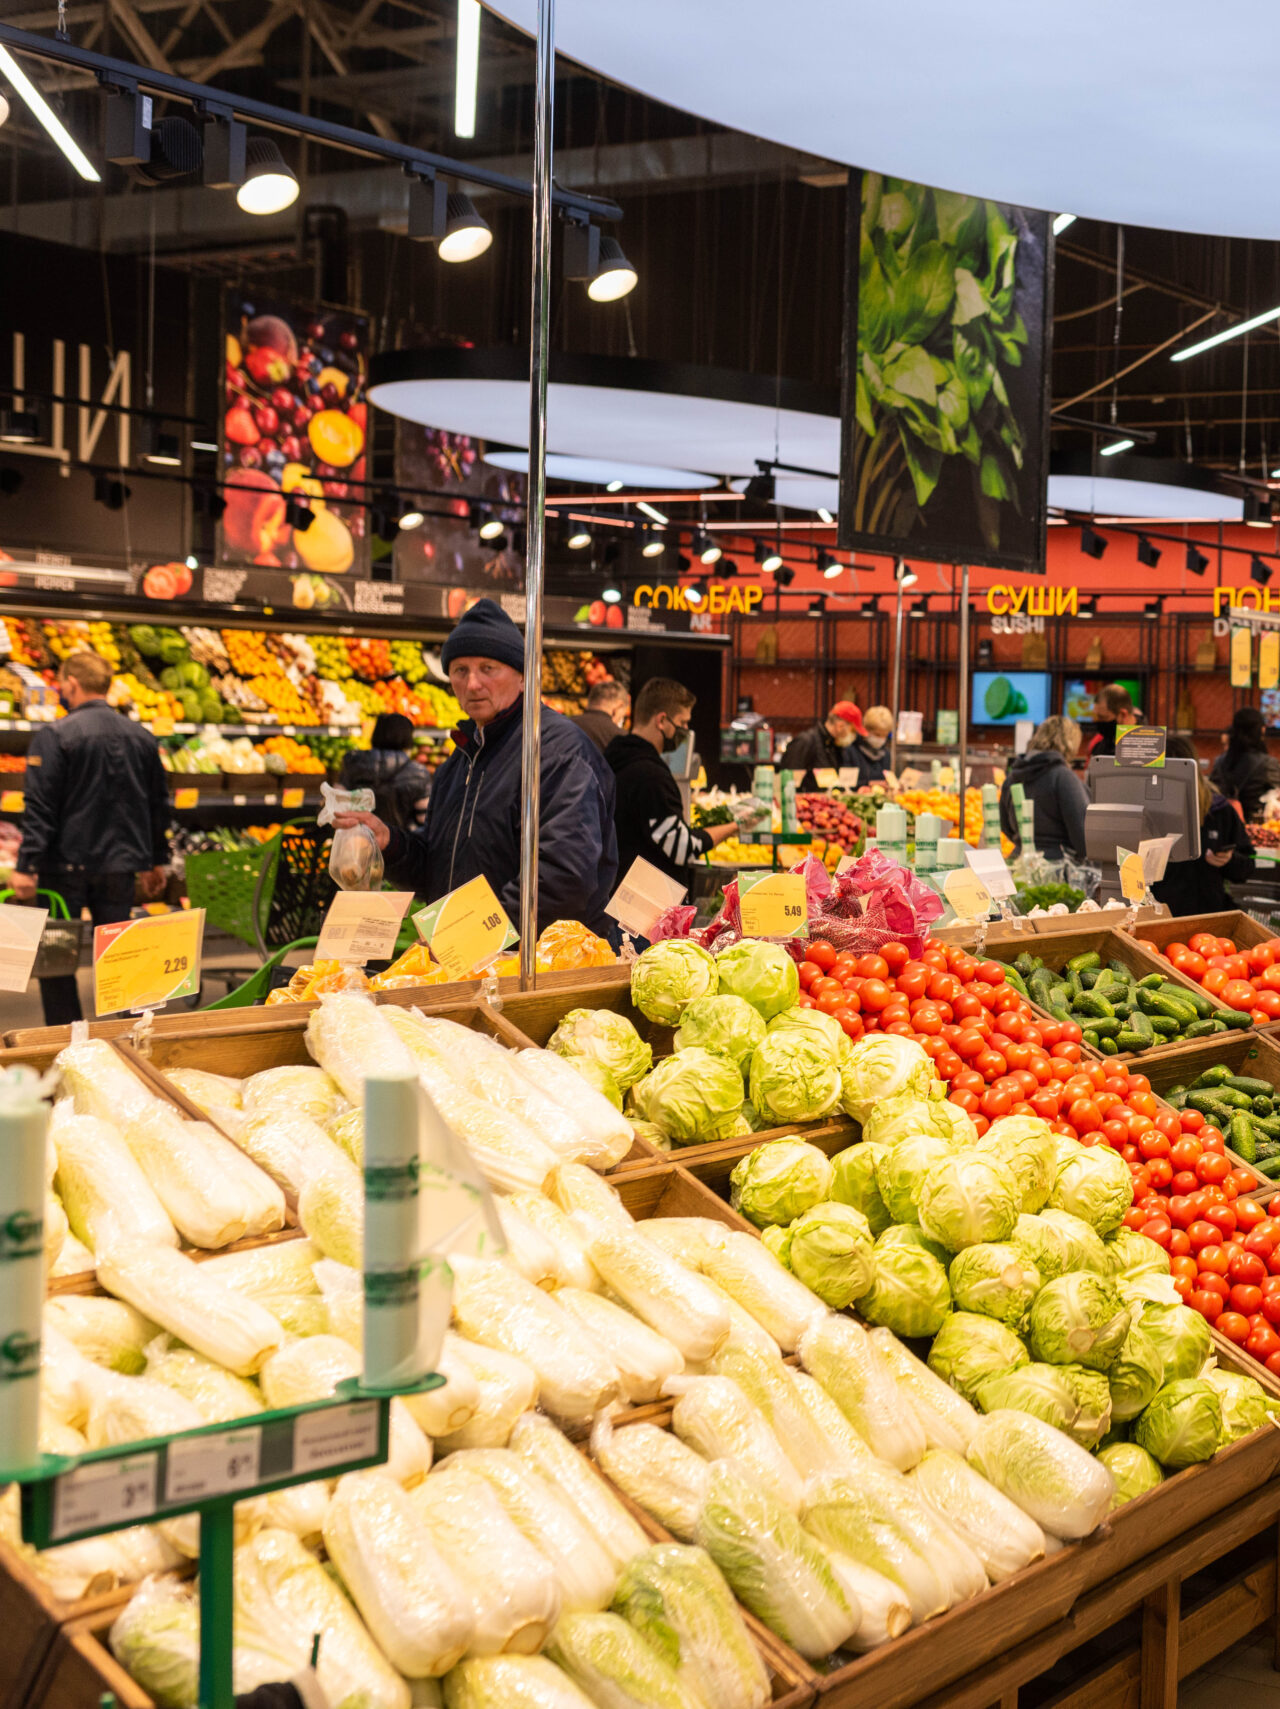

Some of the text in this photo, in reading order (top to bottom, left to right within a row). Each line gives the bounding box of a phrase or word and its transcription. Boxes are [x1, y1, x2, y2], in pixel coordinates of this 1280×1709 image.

[987, 584, 1078, 616] СУШИ
[991, 615, 1045, 634] SUSHI
[784, 905, 802, 917] 5.49
[482, 913, 502, 931] 1.08
[163, 956, 188, 974] 2.29
